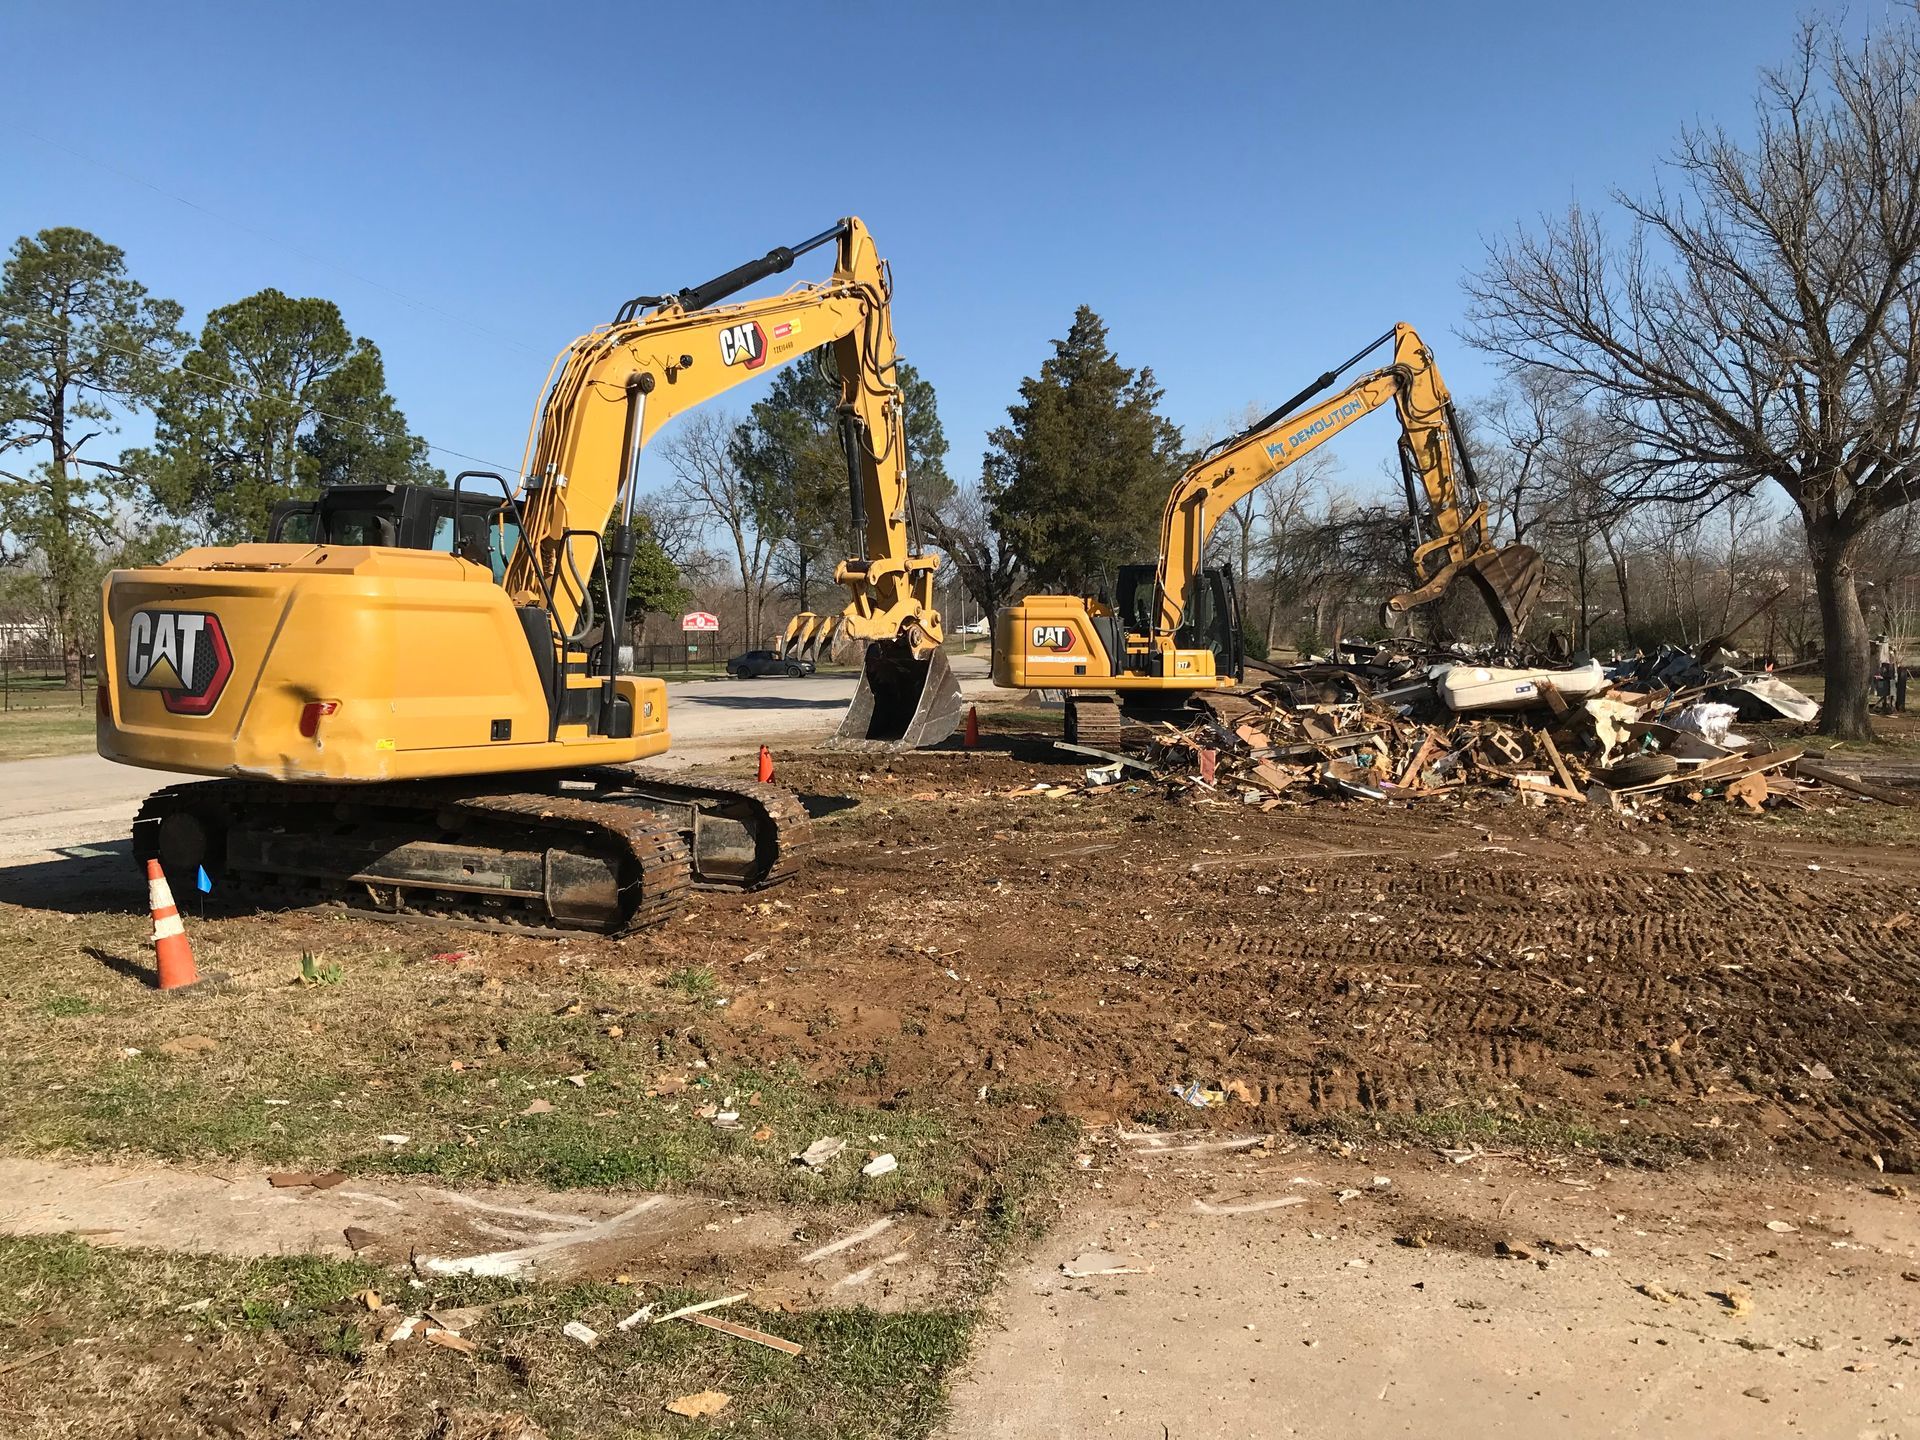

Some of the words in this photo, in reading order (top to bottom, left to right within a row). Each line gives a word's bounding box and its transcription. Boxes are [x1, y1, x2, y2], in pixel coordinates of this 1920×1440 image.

[720, 322, 756, 365] CAT
[1288, 399, 1362, 448] DEMOLITION
[128, 612, 204, 689] CAT
[1033, 627, 1066, 646] CAT
